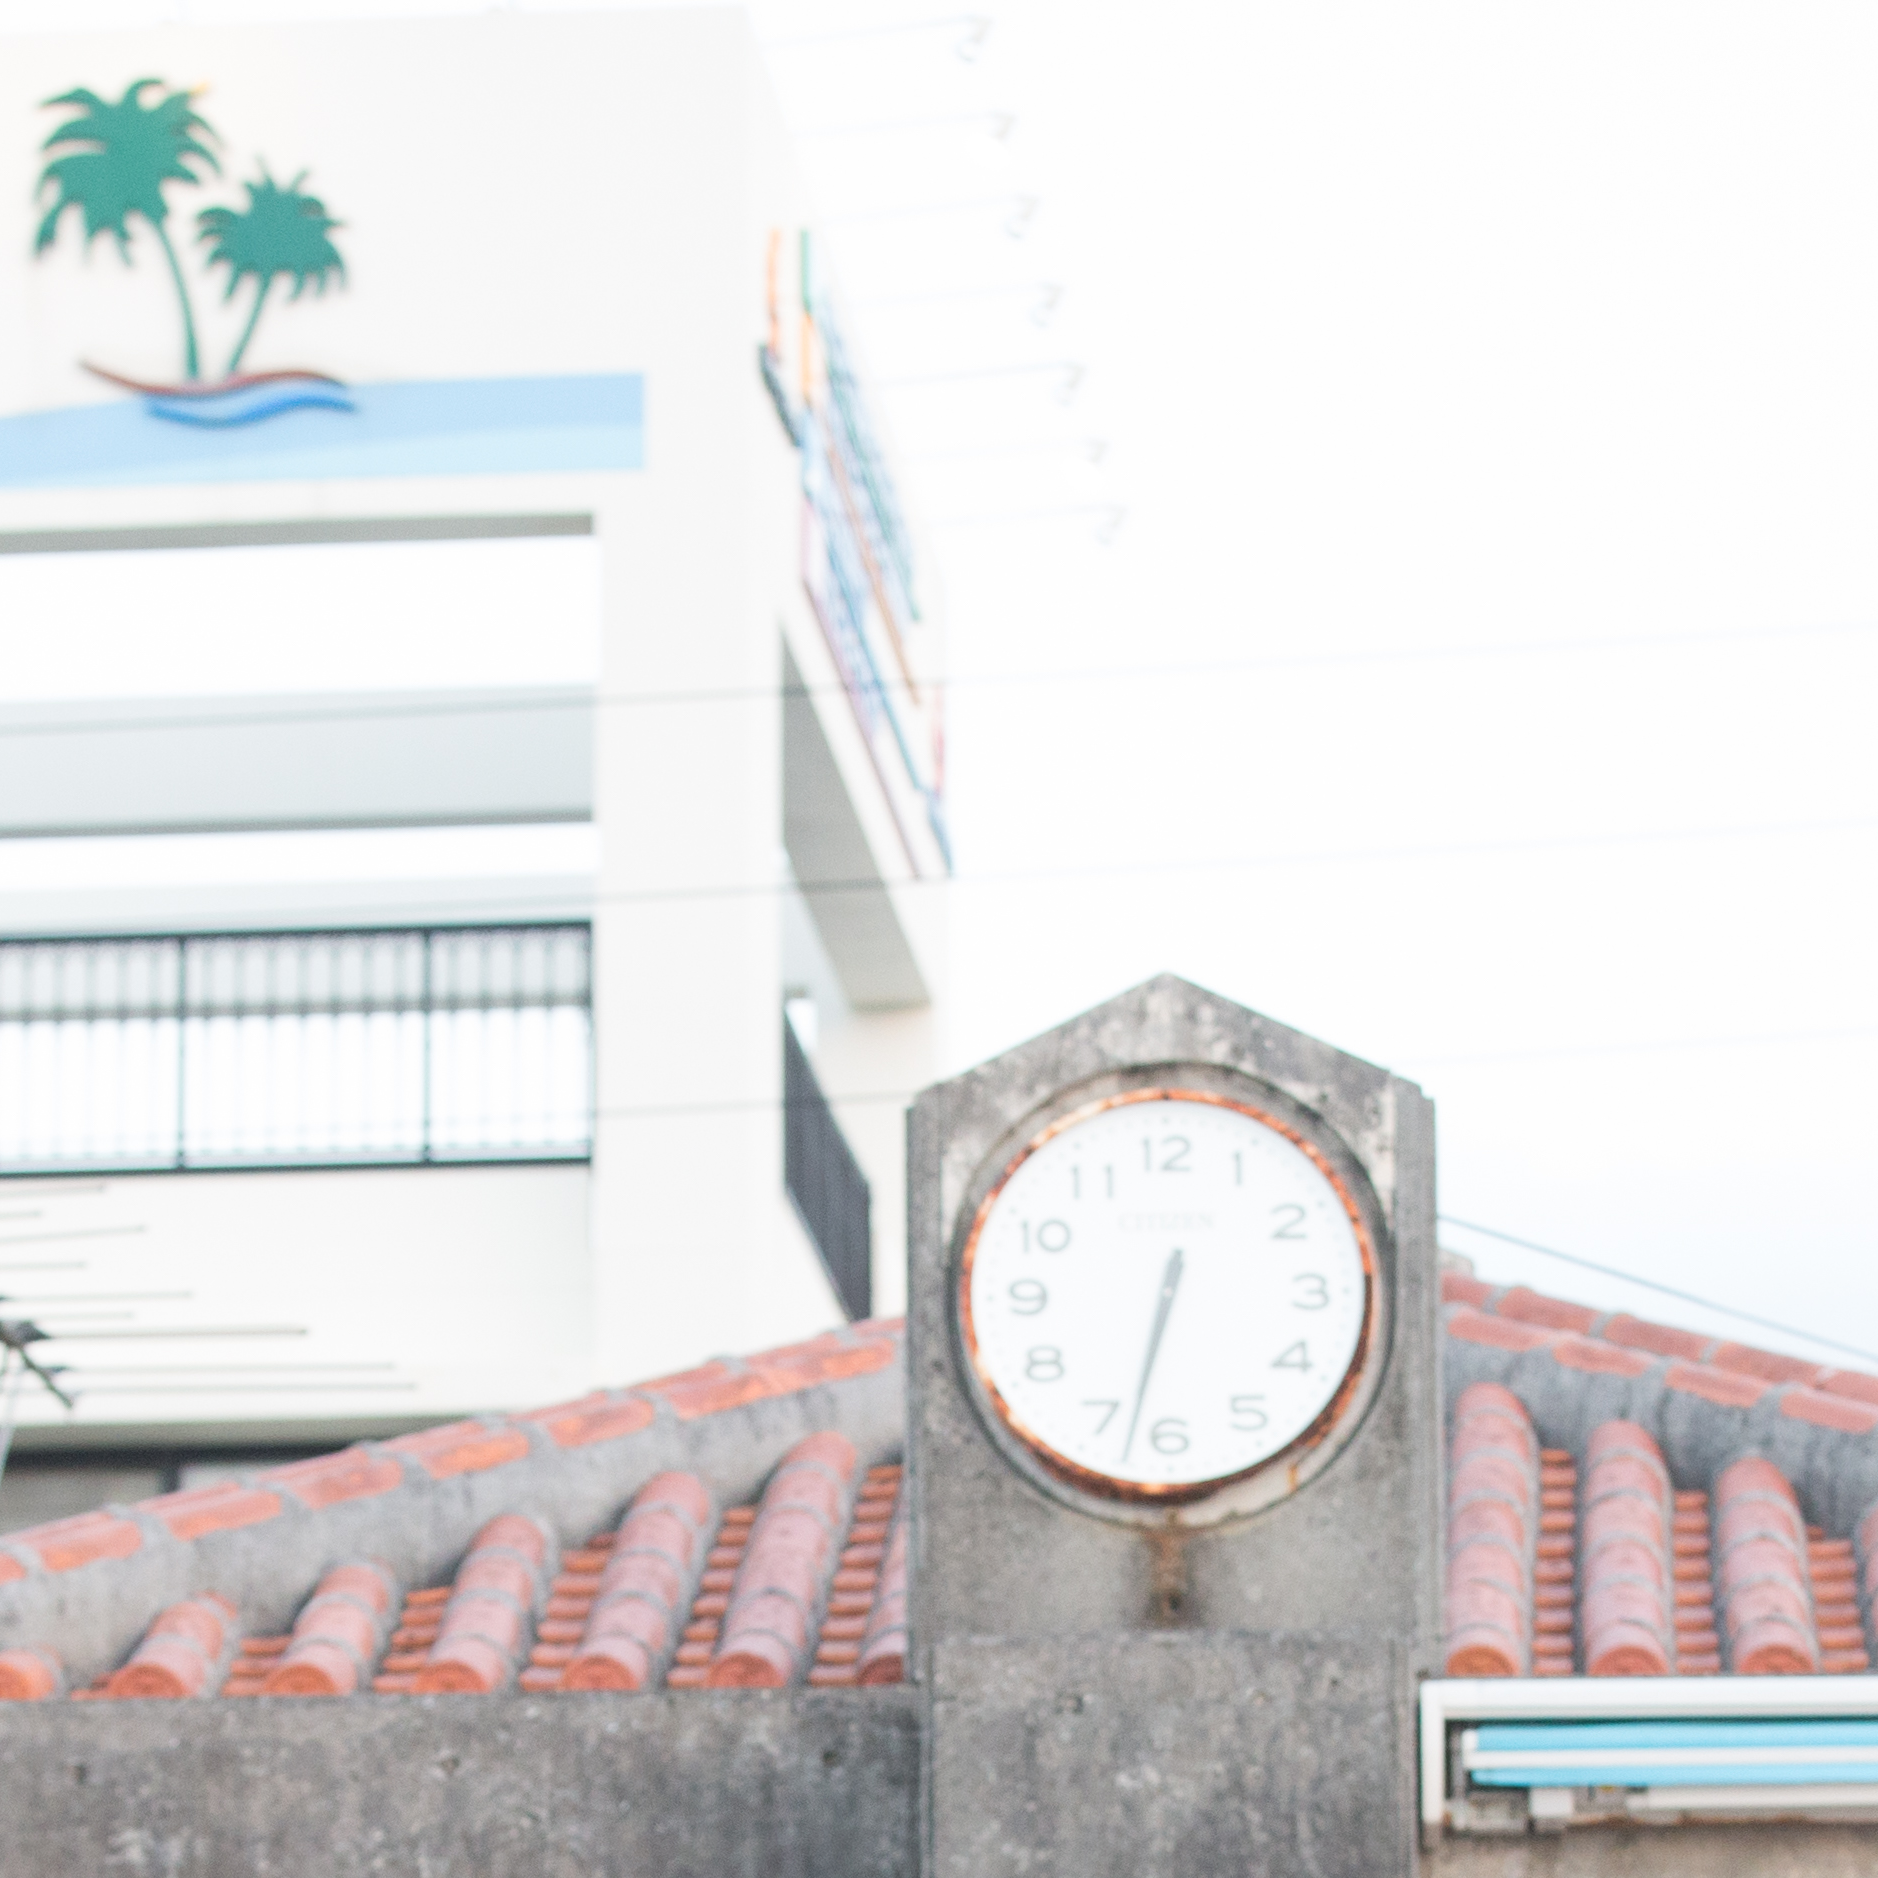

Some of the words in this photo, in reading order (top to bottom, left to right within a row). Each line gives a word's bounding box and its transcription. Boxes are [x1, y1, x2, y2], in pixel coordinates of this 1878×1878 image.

[1142, 1136, 1192, 1172] 12
[1233, 1152, 1244, 1185] 1
[1071, 1165, 1114, 1199] 11
[1023, 1219, 1071, 1254] 10
[1270, 1204, 1308, 1239] 2
[1009, 1279, 1048, 1315] 9
[1290, 1274, 1328, 1310] 3
[1025, 1346, 1065, 1382] 8
[1271, 1340, 1313, 1373] 4
[1082, 1401, 1120, 1435] 7
[1230, 1395, 1268, 1431] 5
[1150, 1419, 1190, 1455] 6
